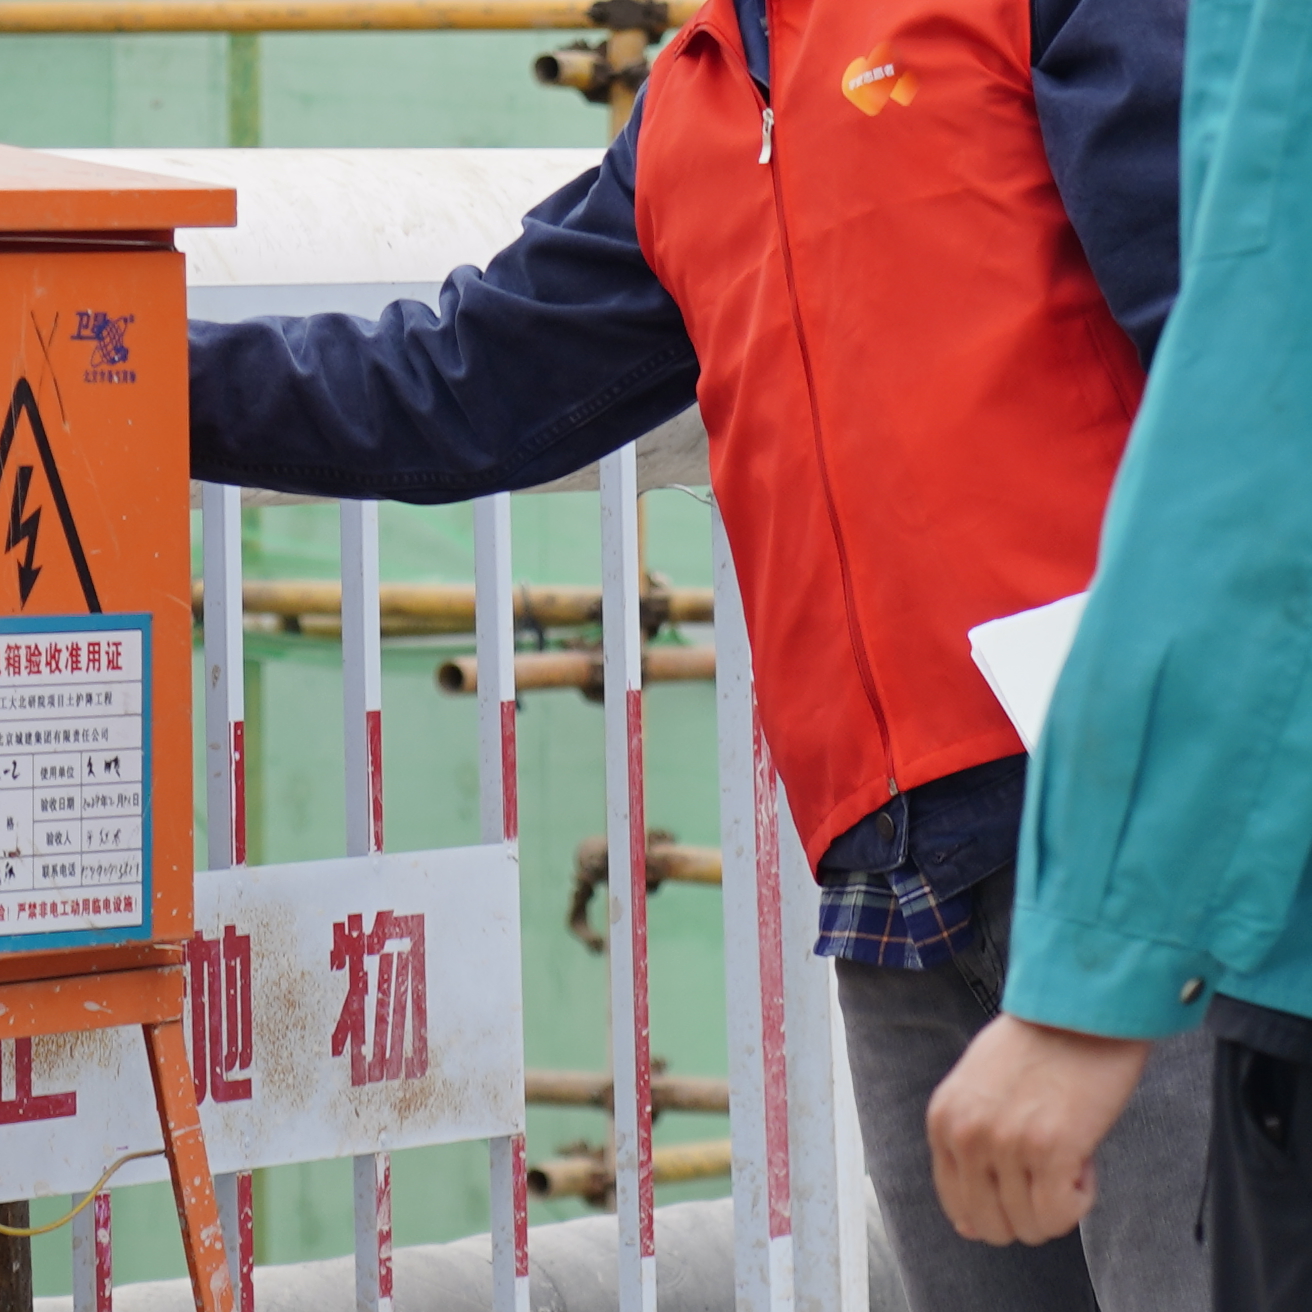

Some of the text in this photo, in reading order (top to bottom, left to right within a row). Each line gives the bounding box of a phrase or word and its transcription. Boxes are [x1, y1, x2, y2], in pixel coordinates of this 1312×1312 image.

[40, 765, 74, 781] 使用单位
[40, 796, 75, 812] 验收日期
[46, 830, 72, 846] 验收人
[42, 862, 76, 879] 联系电话
